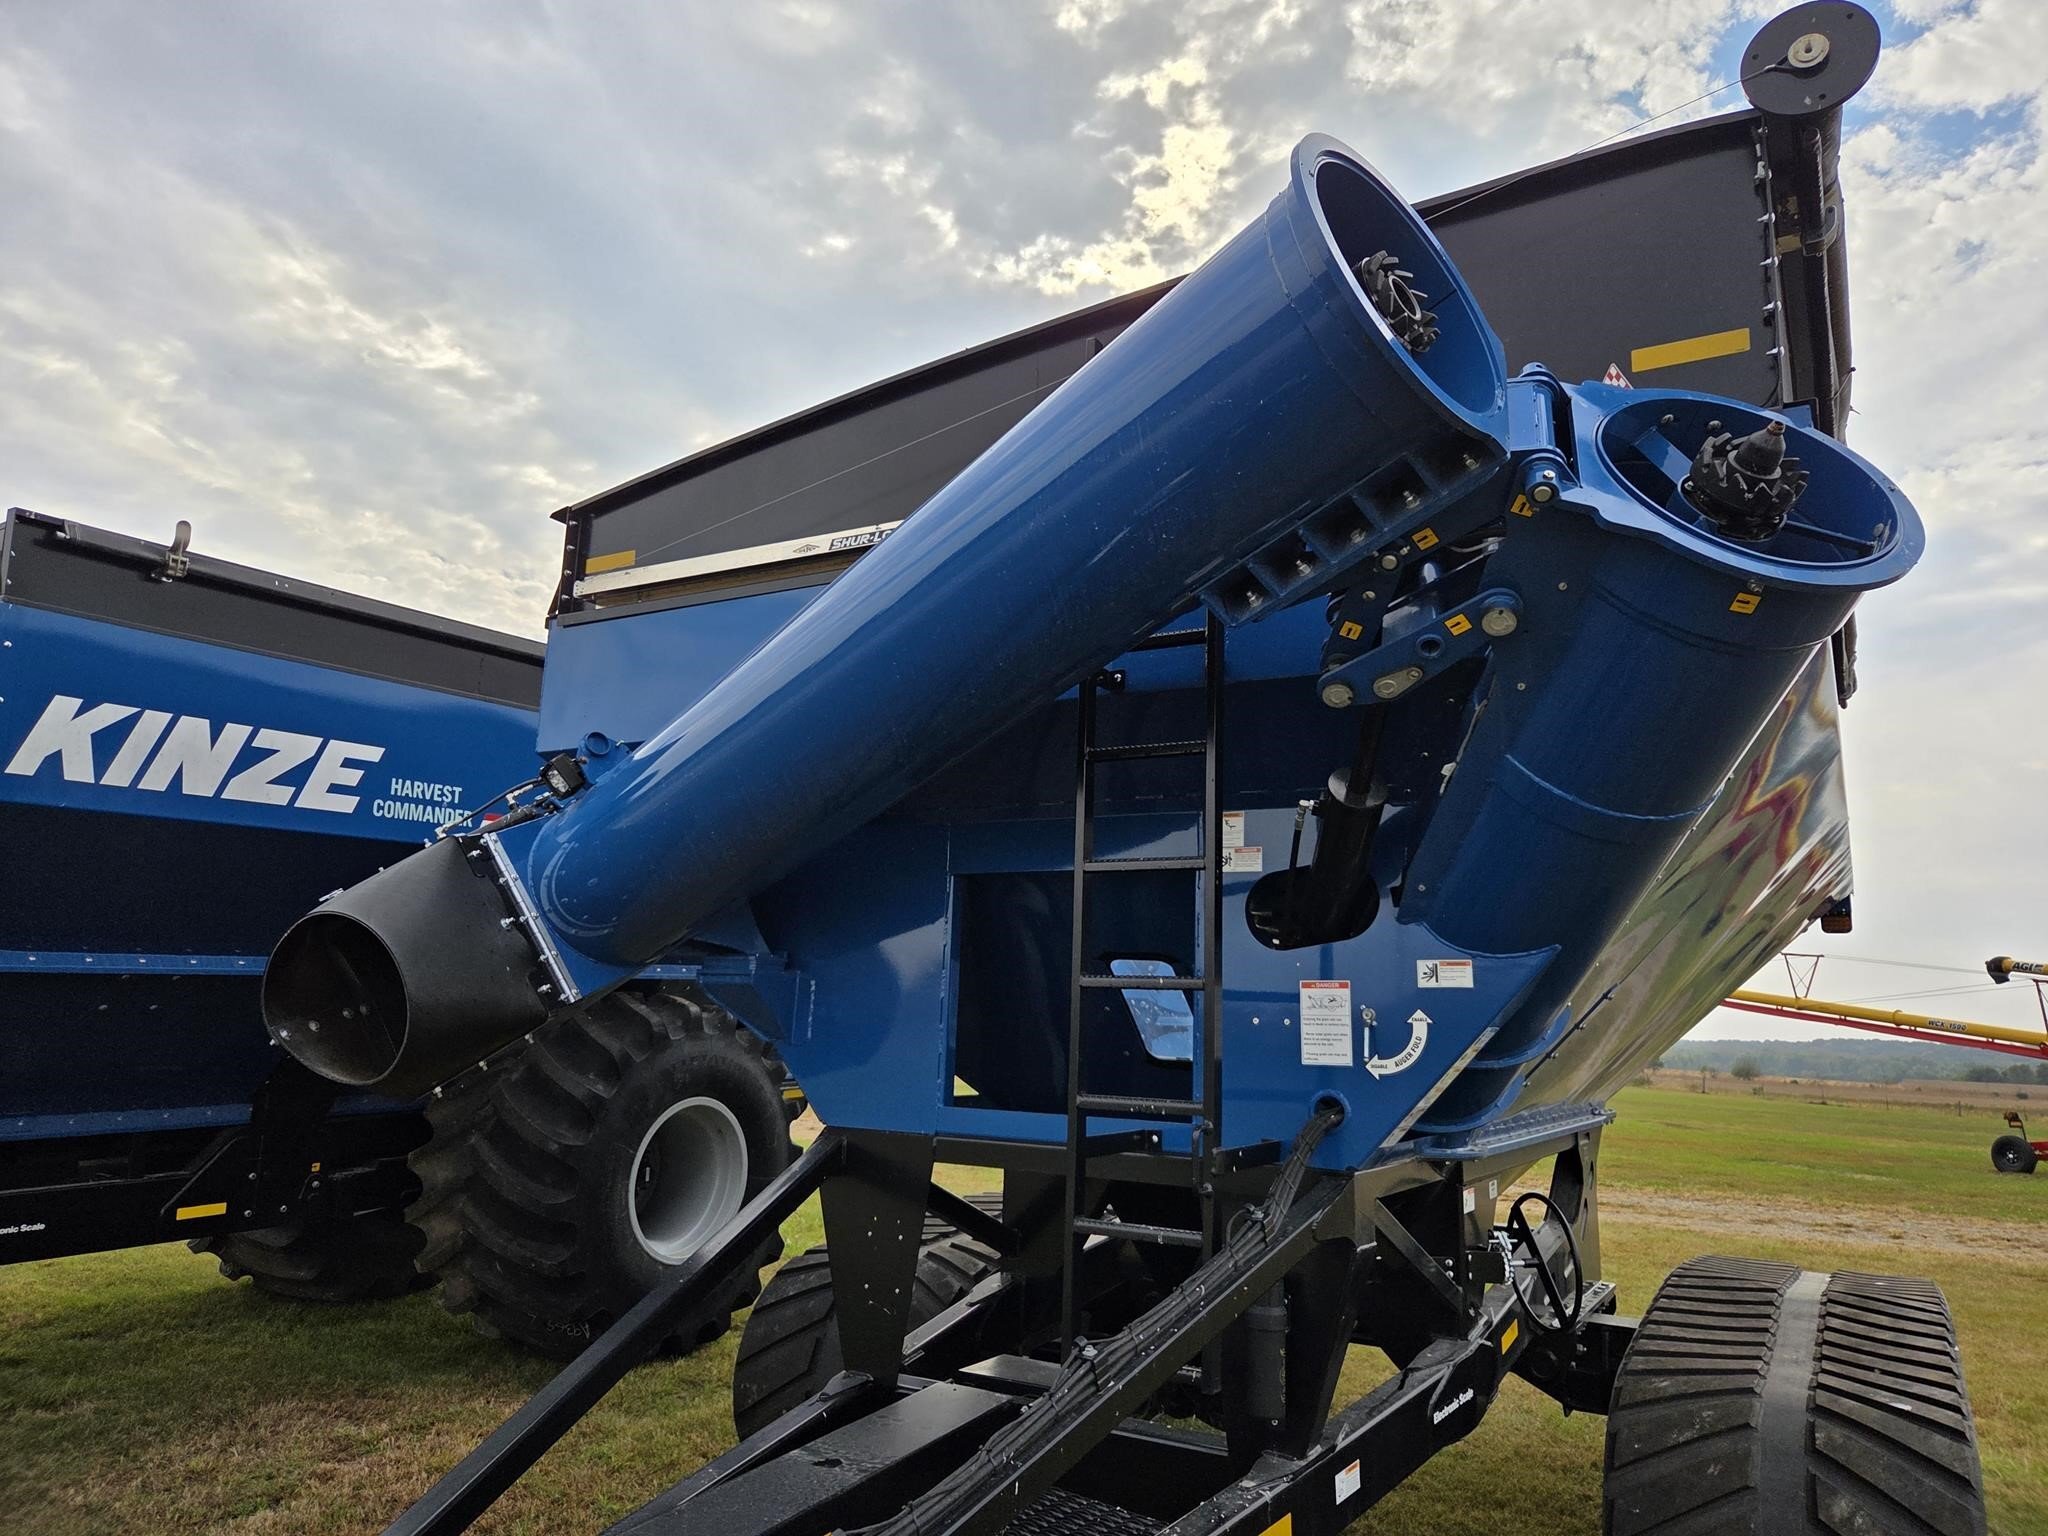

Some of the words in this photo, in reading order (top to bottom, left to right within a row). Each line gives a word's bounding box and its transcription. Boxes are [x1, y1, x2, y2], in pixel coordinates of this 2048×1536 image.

[4, 694, 386, 814] KINZE
[390, 777, 463, 804] HARVEST
[372, 798, 473, 828] COMMANDER
[1394, 1051, 1414, 1068] AUGER
[1410, 1035, 1423, 1053] FOLD
[20, 1222, 46, 1232] Scale
